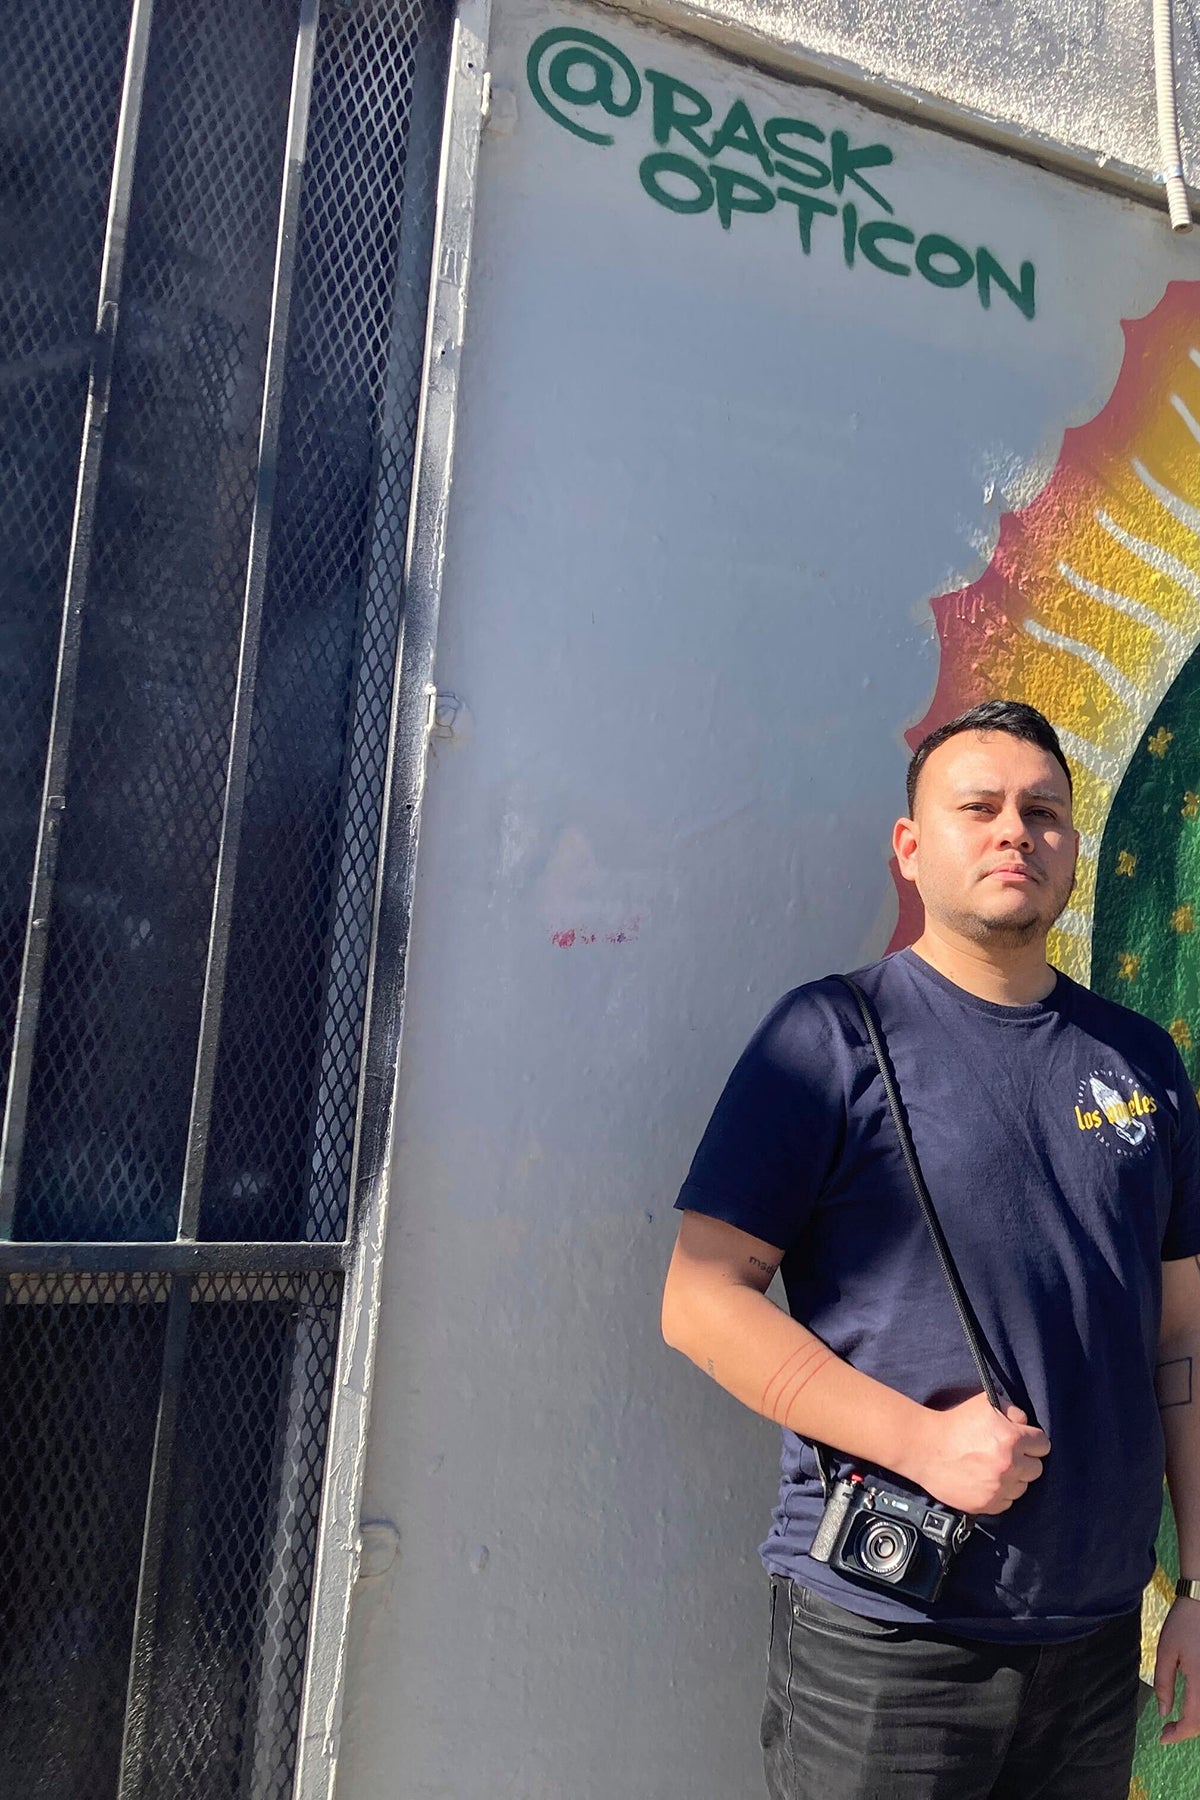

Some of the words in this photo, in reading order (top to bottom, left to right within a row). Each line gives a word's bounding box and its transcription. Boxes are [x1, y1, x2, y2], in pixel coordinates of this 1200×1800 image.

[526, 27, 894, 215] @RASK
[639, 151, 1036, 321] OPTICON
[1074, 1105, 1102, 1131] los
